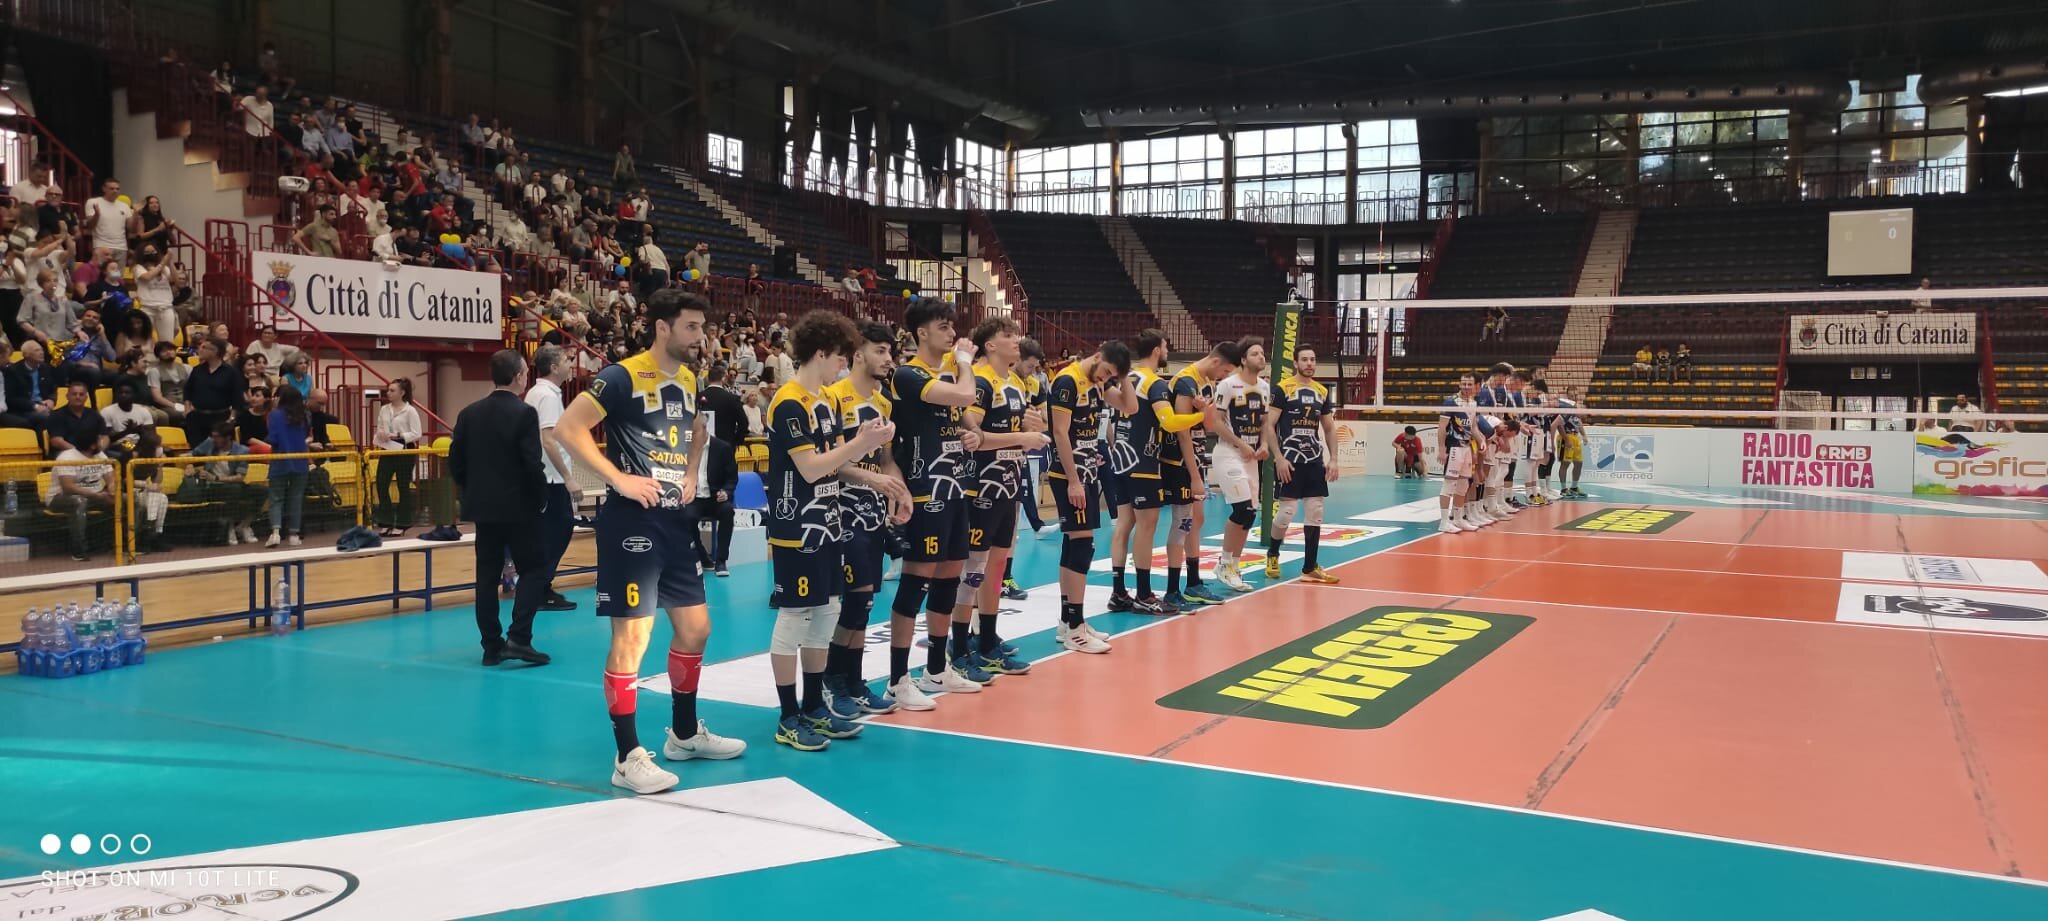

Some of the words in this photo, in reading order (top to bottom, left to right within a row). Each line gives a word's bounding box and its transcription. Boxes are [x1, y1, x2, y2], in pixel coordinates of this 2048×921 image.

[306, 273, 370, 318] Città
[378, 280, 401, 319] di
[408, 282, 494, 325] Catania
[1283, 312, 1299, 361] BANCA
[1824, 323, 1867, 345] Città
[1873, 322, 1891, 345] di
[1896, 322, 1968, 345] Catania
[1250, 411, 1257, 425] 1
[1304, 406, 1312, 417] 7
[1010, 415, 1020, 432] 12
[668, 425, 679, 448] 6
[1743, 432, 1812, 459] RADIO
[648, 450, 689, 465] SATURN
[1828, 446, 1867, 460] RMB
[1742, 460, 1875, 488] FANTASTICA
[1934, 457, 2048, 480] grafic
[1180, 486, 1191, 499] 10
[924, 536, 939, 555] 15
[970, 528, 984, 546] 12
[626, 583, 640, 608] 6
[798, 576, 809, 597] 8
[1216, 611, 1492, 718] CREDEM
